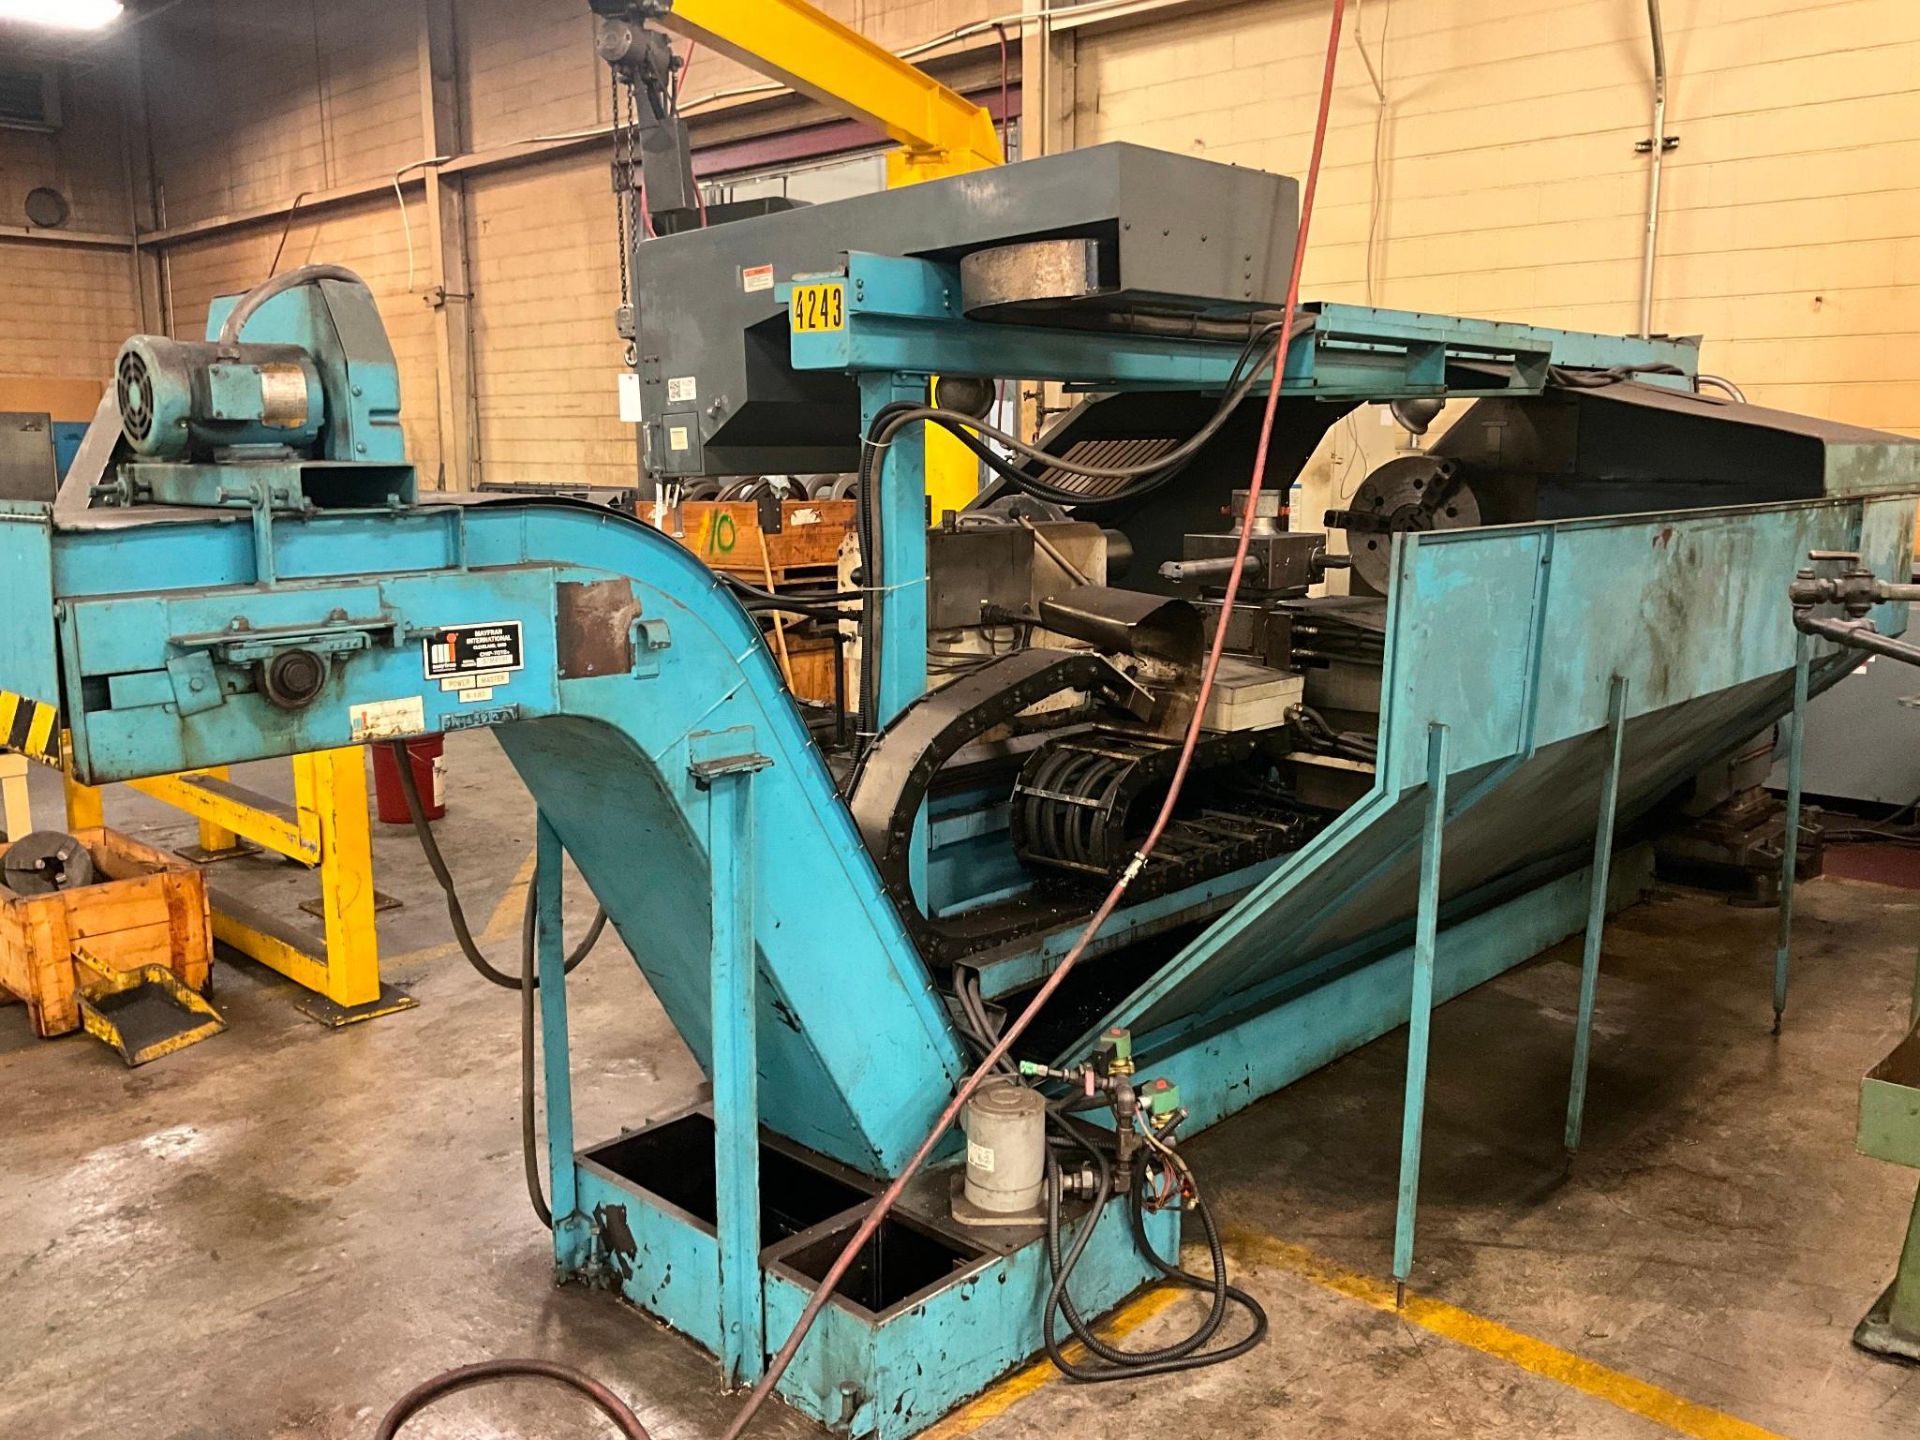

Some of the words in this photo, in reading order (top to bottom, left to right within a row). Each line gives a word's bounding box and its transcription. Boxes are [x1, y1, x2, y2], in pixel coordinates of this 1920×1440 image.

[796, 287, 842, 329] 4243
[708, 507, 737, 555] 10
[474, 629, 503, 637] MAYFRAN
[466, 635, 512, 644] INTERNATIONAL
[449, 678, 470, 687] POWER
[481, 675, 505, 683] MASTER
